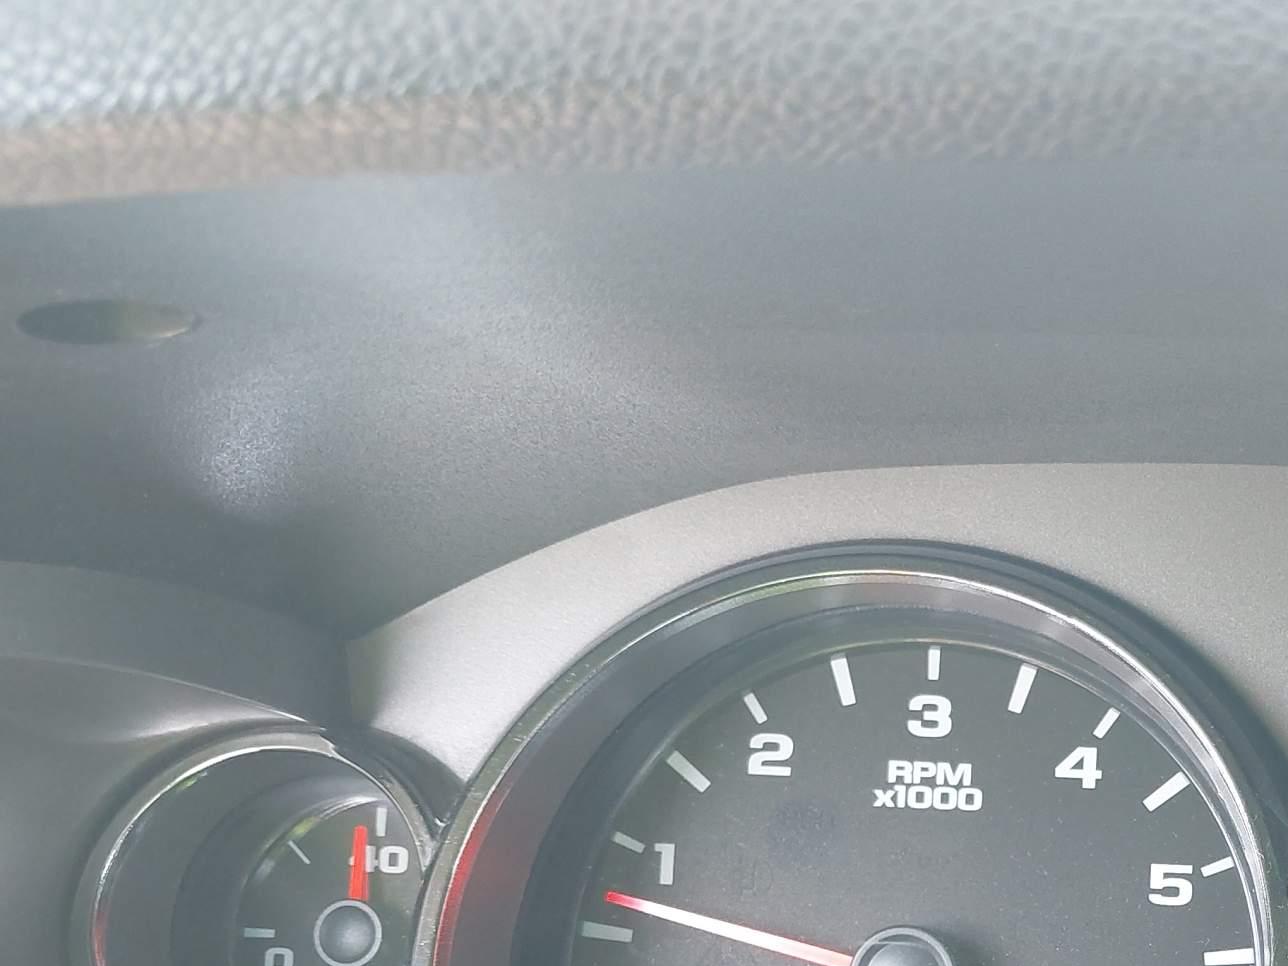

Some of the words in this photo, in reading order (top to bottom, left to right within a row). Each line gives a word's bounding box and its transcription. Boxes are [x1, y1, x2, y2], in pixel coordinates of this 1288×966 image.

[908, 695, 951, 737] 3
[748, 733, 793, 776] 2
[888, 760, 971, 787] RPM
[1055, 747, 1102, 788] 4
[873, 784, 982, 810] x1000
[655, 844, 675, 885] 1
[1149, 864, 1192, 905] 5
